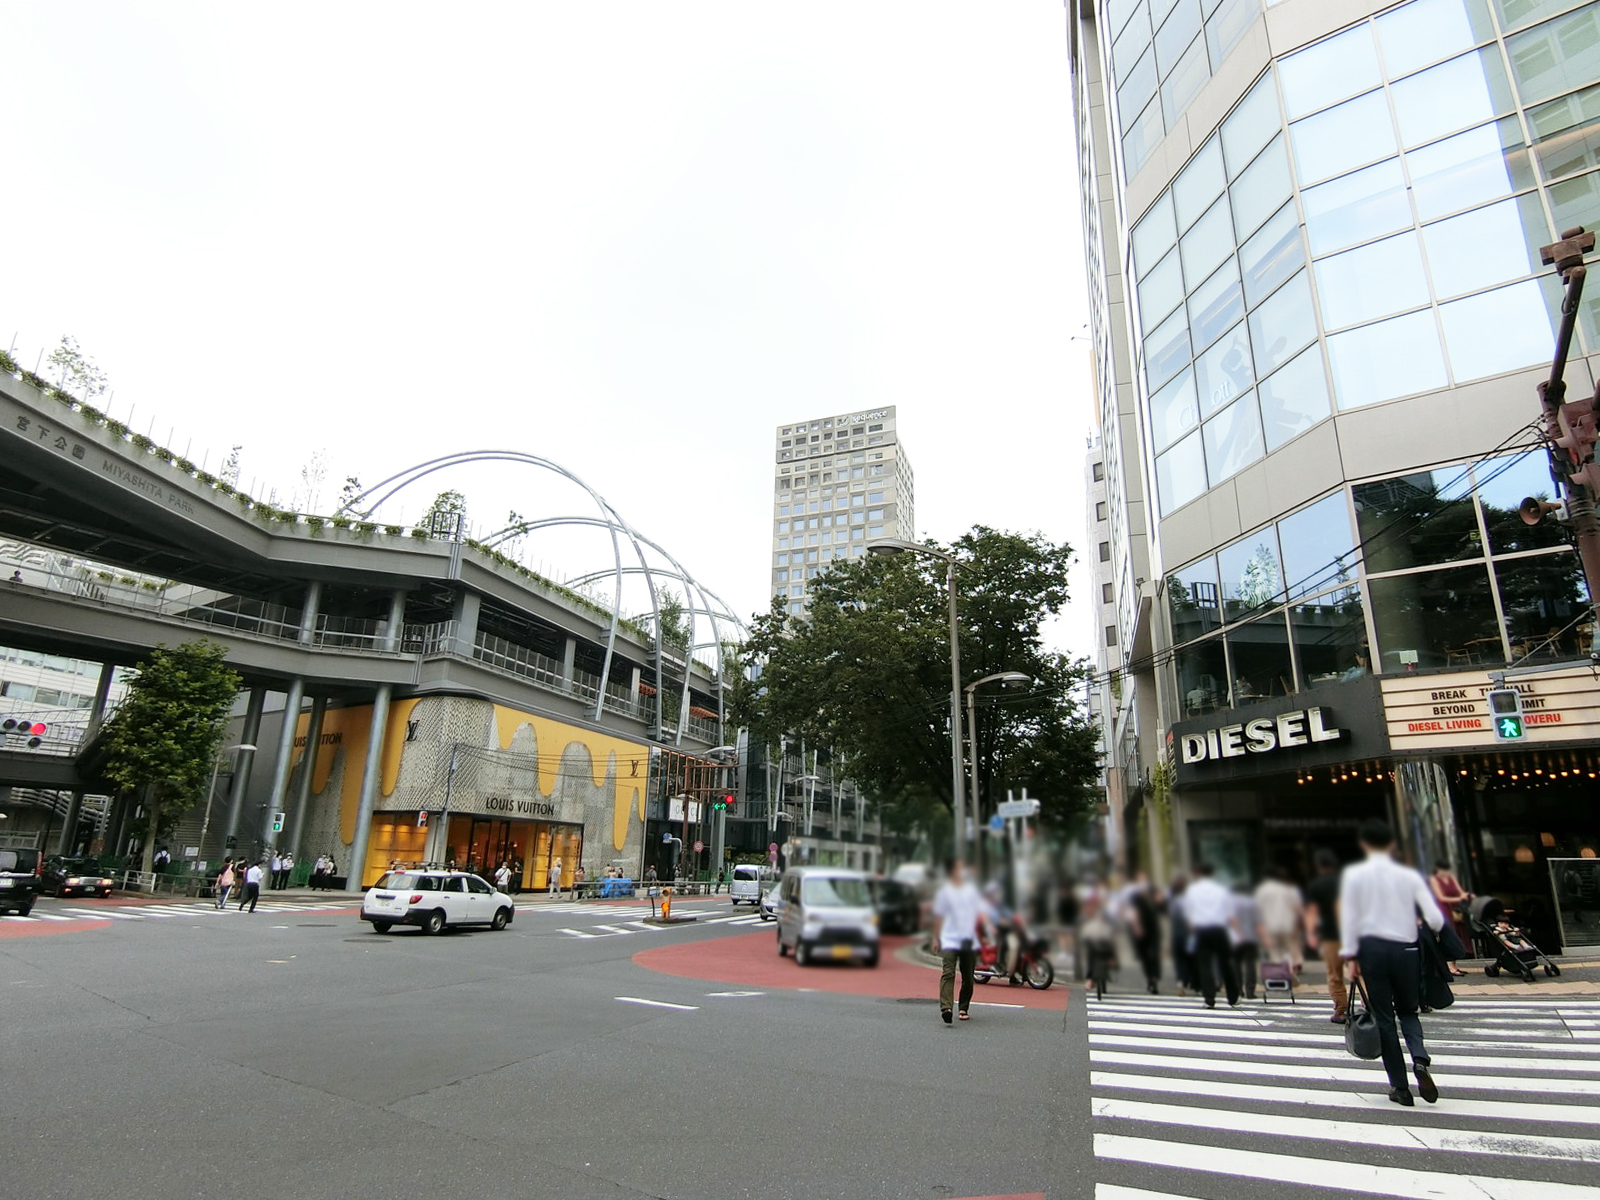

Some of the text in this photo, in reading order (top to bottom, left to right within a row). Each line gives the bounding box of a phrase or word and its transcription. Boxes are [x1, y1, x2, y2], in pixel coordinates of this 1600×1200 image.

[17, 415, 85, 460] 宮下公園
[102, 459, 195, 515] MIYASHITA PARK
[1431, 690, 1467, 701] BREAK
[1433, 699, 1545, 715] BEYOND IMIT
[1181, 706, 1340, 764] DIESEL
[1408, 720, 1443, 732] DIESEL
[1446, 719, 1481, 730] LIVING
[485, 797, 555, 816] LOUIS VUITTON
